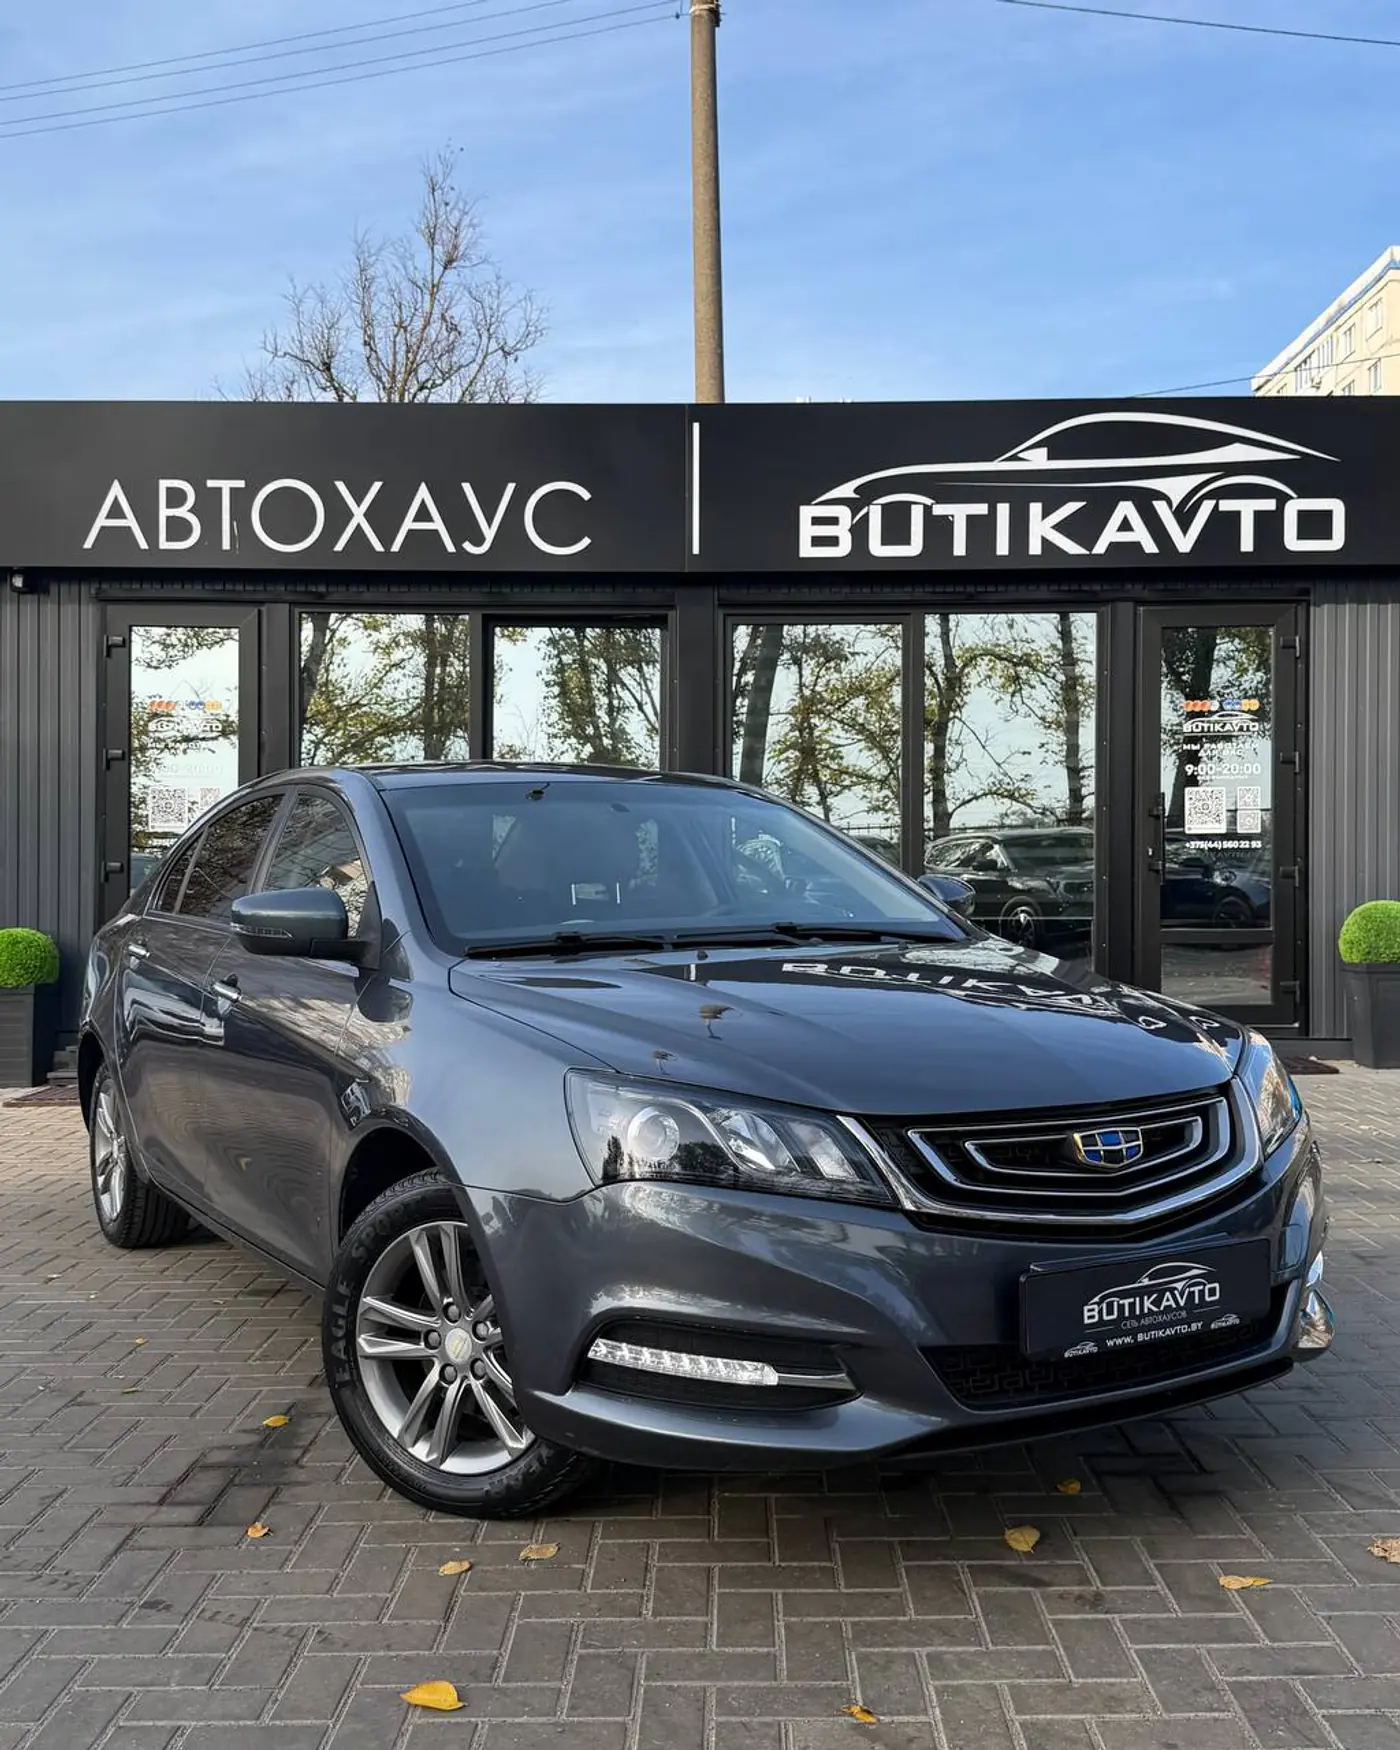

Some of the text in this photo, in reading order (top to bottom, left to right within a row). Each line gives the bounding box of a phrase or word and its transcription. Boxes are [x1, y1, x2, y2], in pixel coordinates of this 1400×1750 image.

[82, 478, 592, 555] АВТОХАУС
[798, 496, 1346, 559] BUTIKAVTO
[1183, 722, 1259, 732] BUTIKAVTO
[1185, 763, 1262, 775] 9:00-20:00
[1083, 1283, 1220, 1324] BUTIKAVTO
[1120, 1310, 1188, 1330] СЕТЬ АВТОХАУСОВ
[329, 1280, 354, 1385] EAGLE
